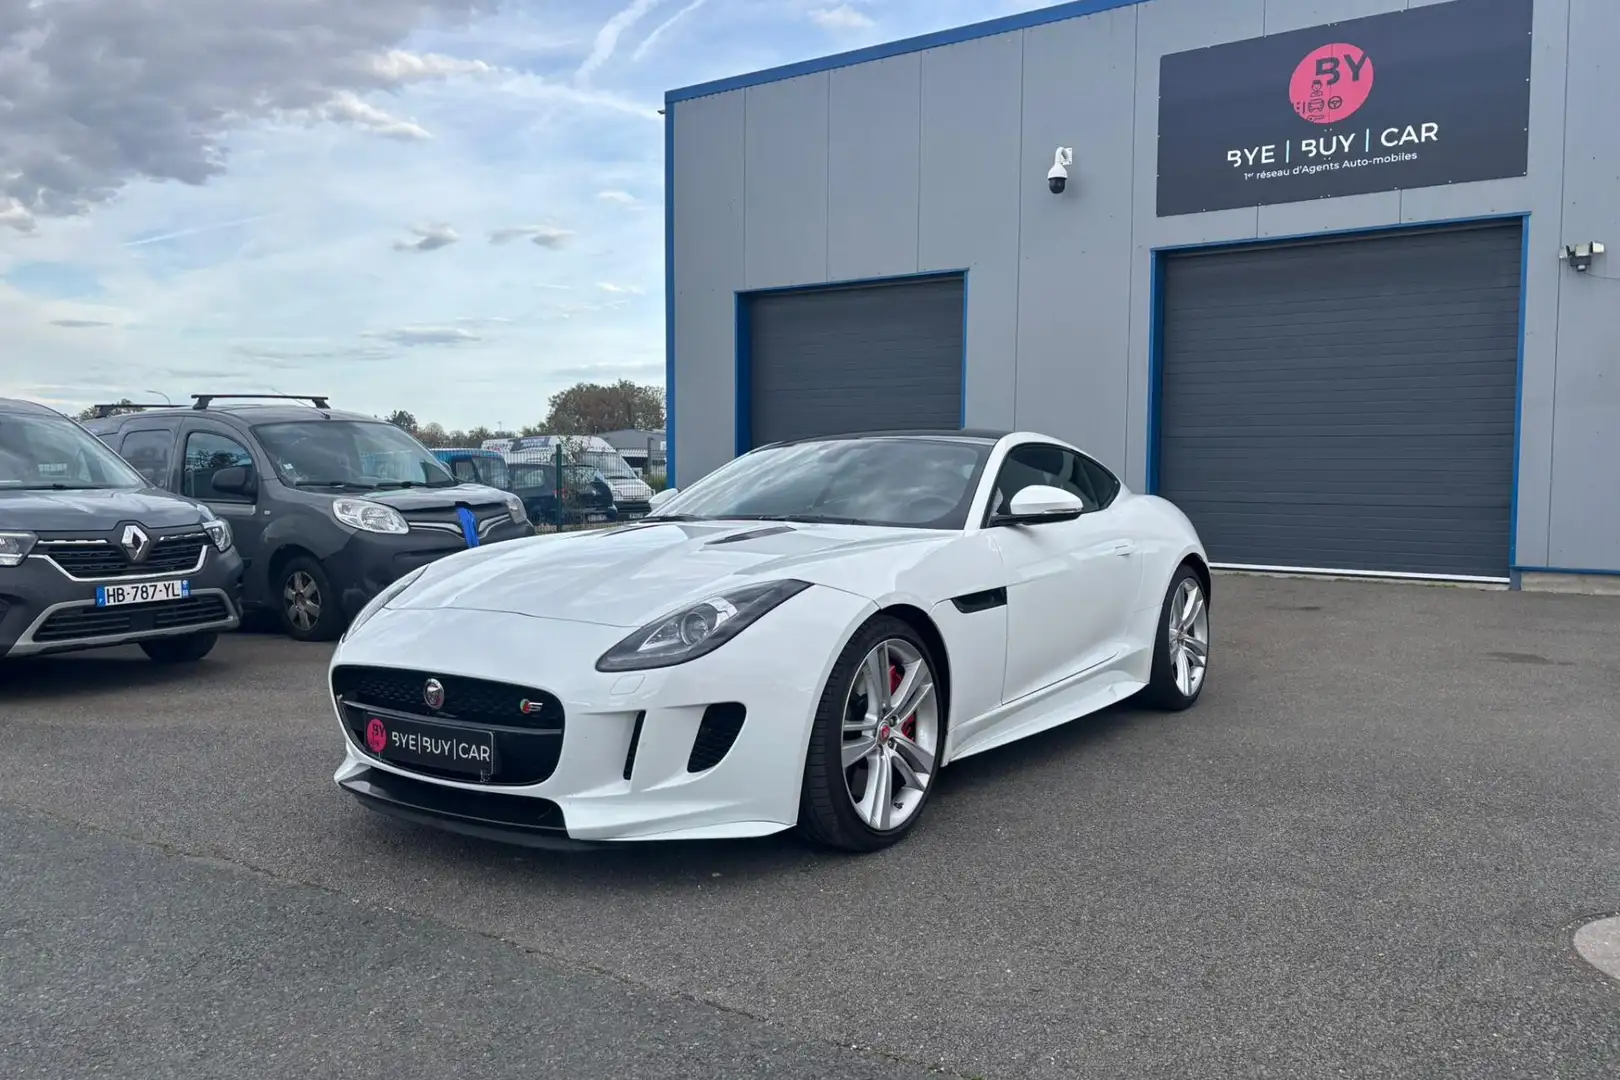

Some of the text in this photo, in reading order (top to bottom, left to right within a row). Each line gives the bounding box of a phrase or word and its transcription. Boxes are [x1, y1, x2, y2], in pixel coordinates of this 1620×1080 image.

[1315, 51, 1367, 86] BY
[1227, 122, 1438, 168] BYE BUY CAR
[1256, 168, 1290, 180] réseau
[1342, 152, 1418, 169] Auto-mobiles
[106, 582, 181, 604] HB-787-YL
[458, 743, 490, 762] CAR
